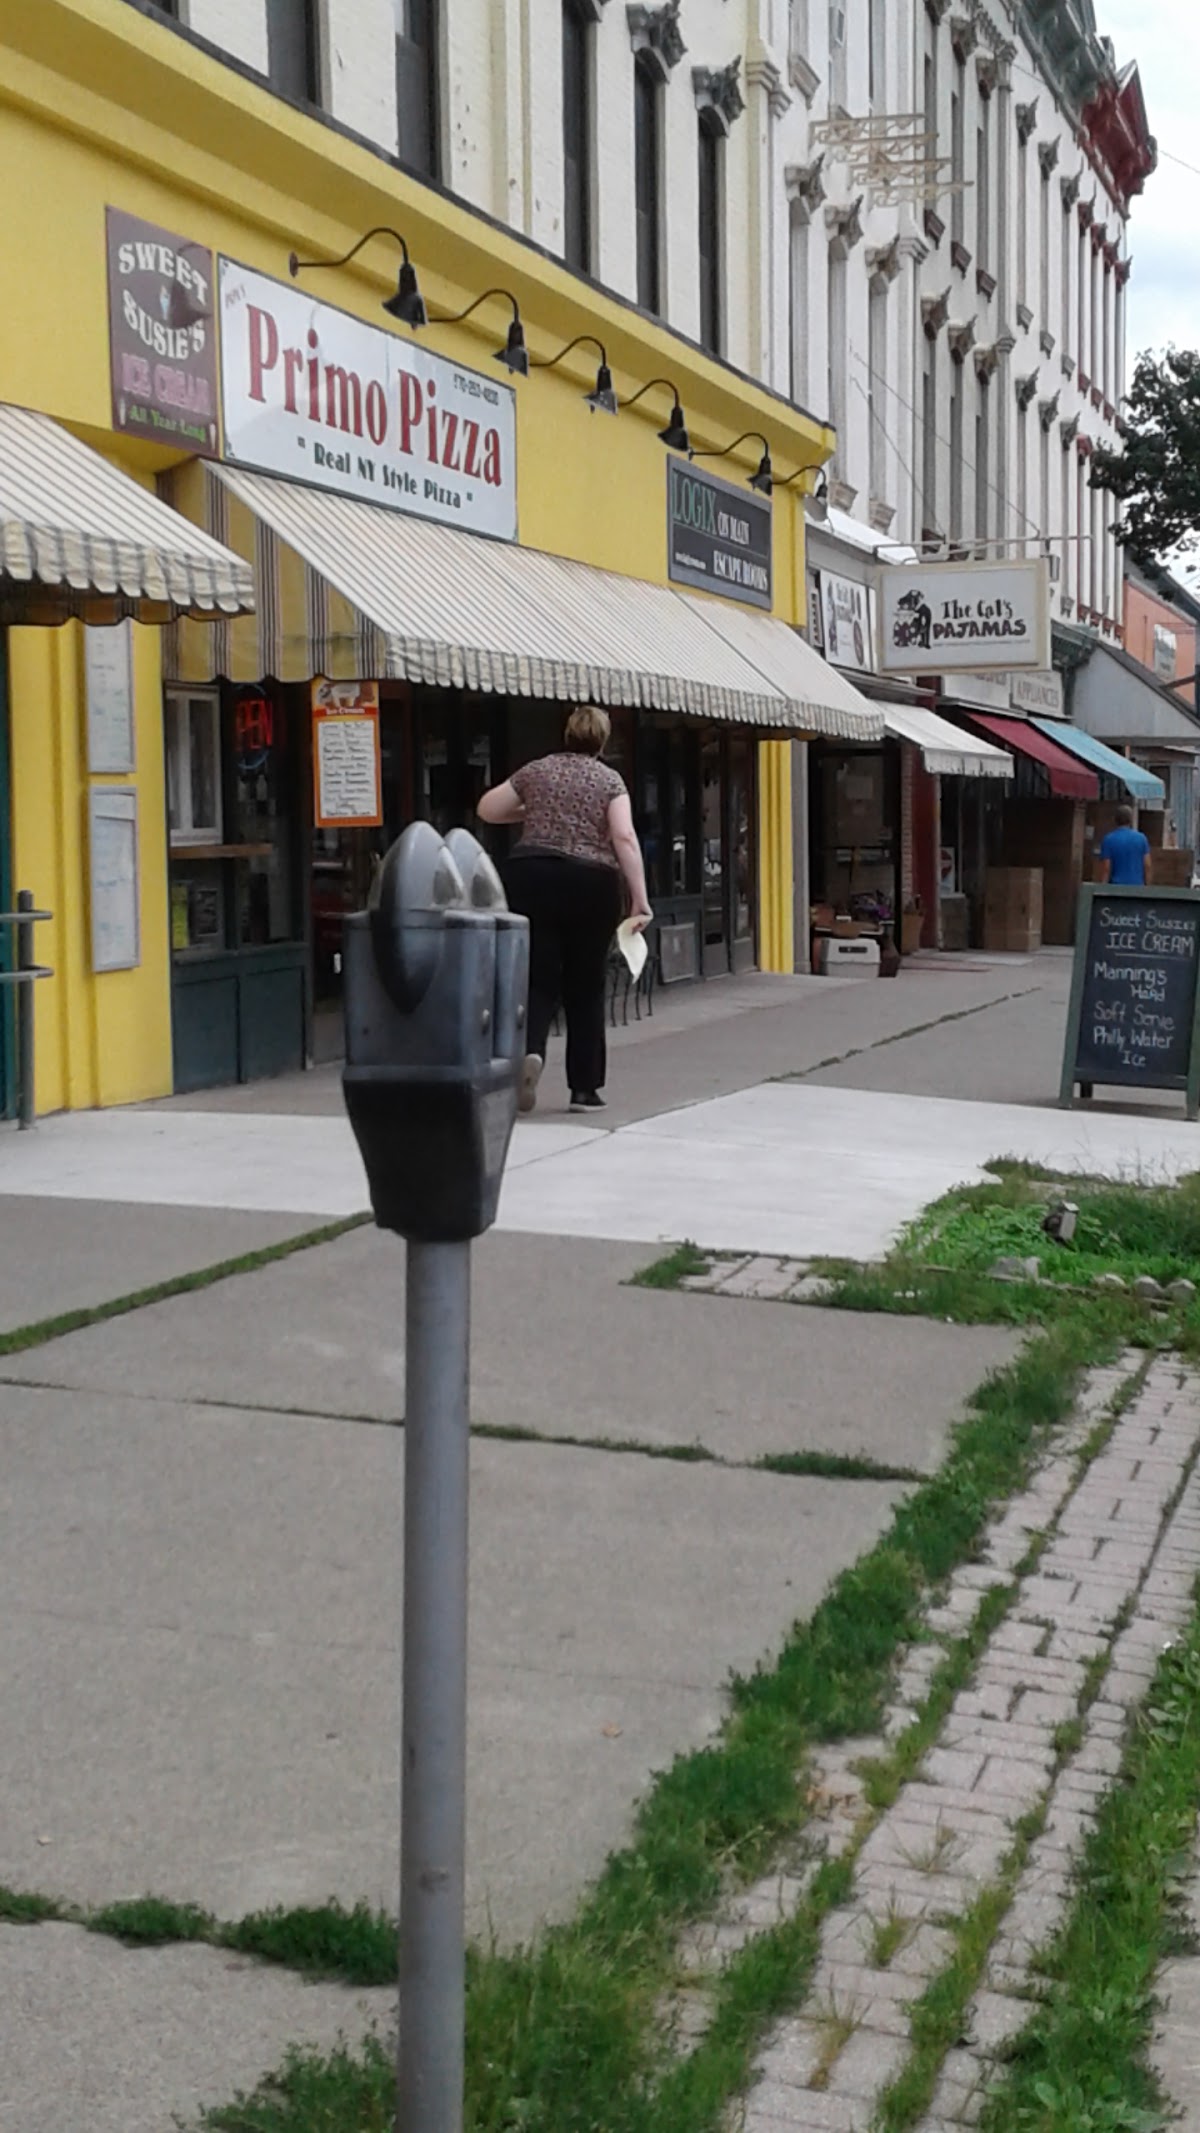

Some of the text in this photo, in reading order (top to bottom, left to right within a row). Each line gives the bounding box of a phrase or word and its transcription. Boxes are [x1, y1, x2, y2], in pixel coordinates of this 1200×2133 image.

[118, 241, 208, 305] SWEET
[123, 289, 205, 360] SUSIE'S
[121, 352, 151, 398] ICE
[247, 303, 502, 487] Primo Pizza
[314, 442, 461, 508] Real NY Style Pizza
[671, 472, 717, 535] LOGIX
[713, 550, 742, 582] ESCAPE
[942, 599, 1013, 619] The Cat's
[932, 620, 1027, 639] PAJAMAS
[1106, 931, 1194, 957] ICE CREAM
[1094, 1001, 1175, 1031] Soft Serve
[1093, 1026, 1174, 1050] Philly Water
[1122, 1050, 1147, 1067] Ice
